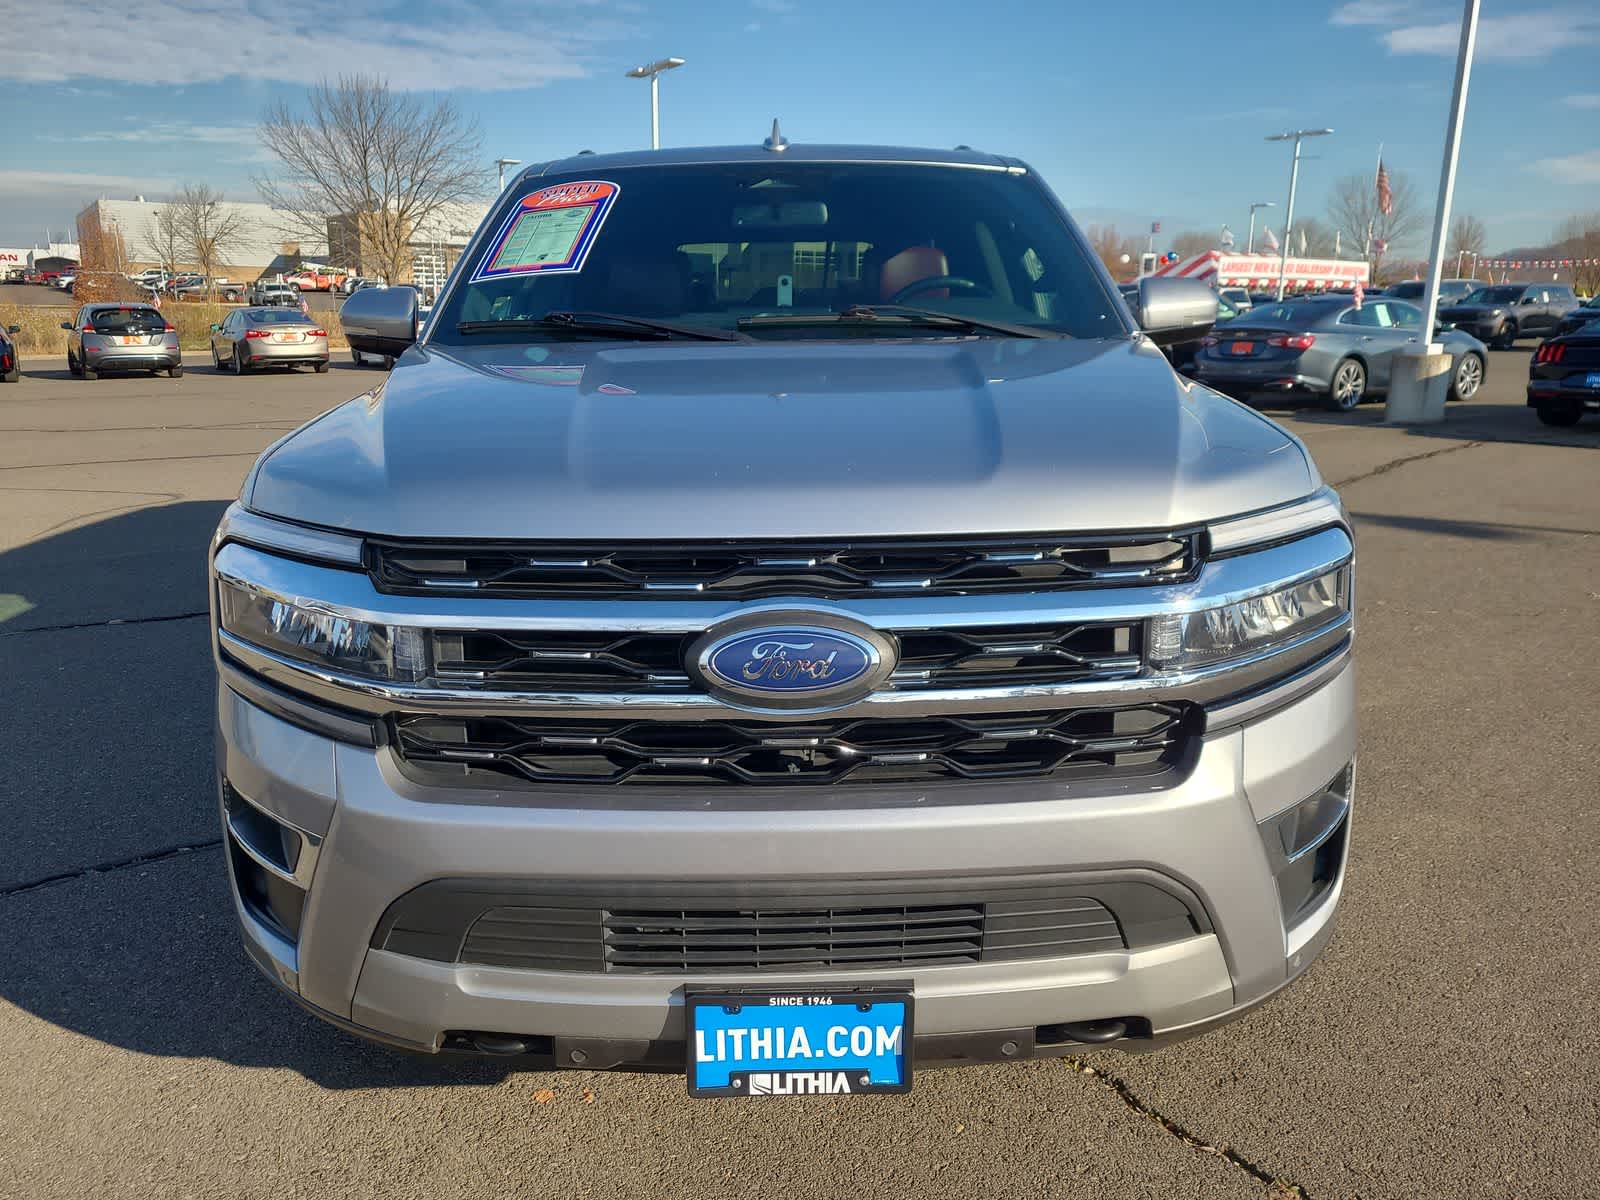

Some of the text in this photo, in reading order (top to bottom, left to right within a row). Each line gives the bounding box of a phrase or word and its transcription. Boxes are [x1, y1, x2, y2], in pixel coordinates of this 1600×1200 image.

[743, 641, 838, 681] Ford
[769, 996, 833, 1006] SINCE 1946
[696, 1025, 903, 1063] LITHIA.COM
[771, 1072, 851, 1095] LITHIA
